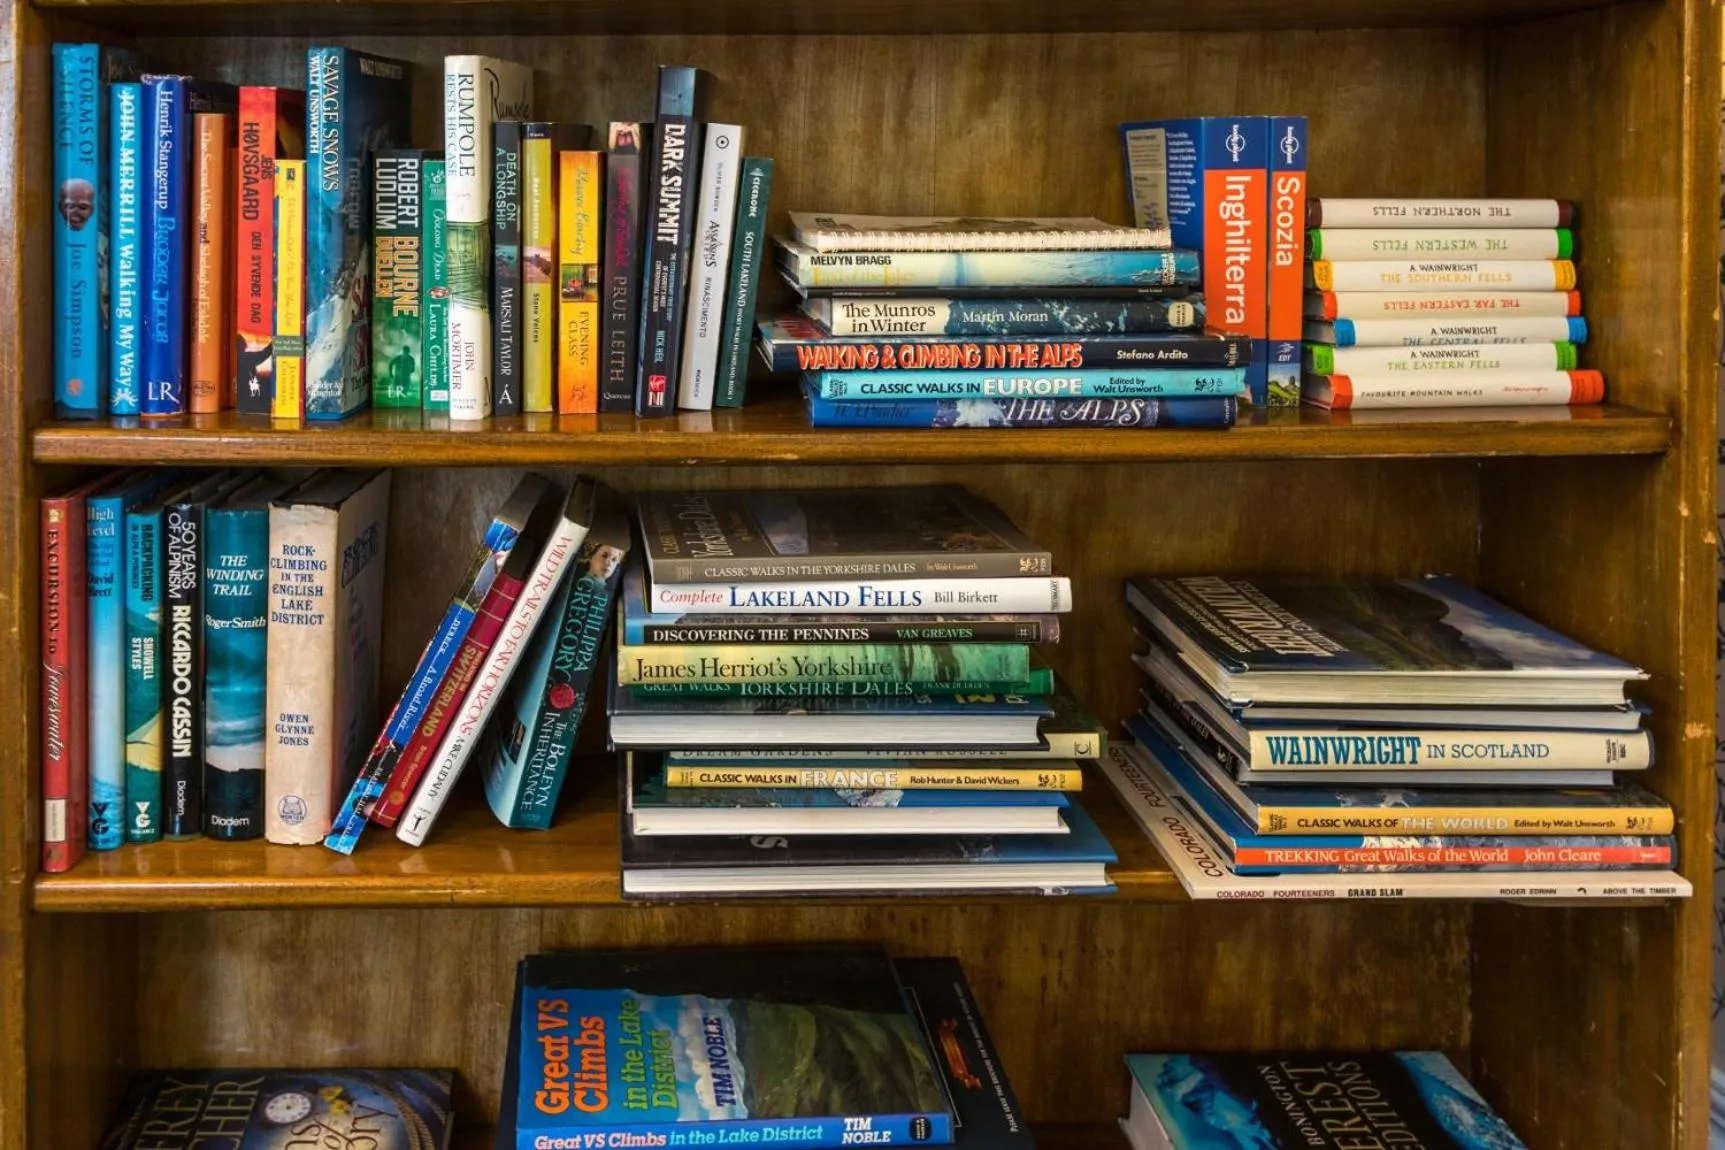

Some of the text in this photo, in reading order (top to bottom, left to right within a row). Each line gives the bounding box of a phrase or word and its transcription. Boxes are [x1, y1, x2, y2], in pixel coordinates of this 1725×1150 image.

[59, 70, 74, 151] SILENCE
[79, 56, 94, 166] STORMS OF
[309, 55, 320, 154] WALT UNSWORTH
[322, 56, 339, 191] SAVAGE SNOWS
[446, 74, 457, 176] RESTS HIS CASE
[458, 74, 475, 176] RUMPOLE
[156, 90, 174, 209] Henrik Stangerup
[261, 155, 275, 179] JENS
[661, 124, 687, 172] DARK
[243, 122, 260, 220] HØVSGAARD
[397, 158, 419, 227] ROBERT
[506, 152, 516, 221] DEATH ON
[375, 158, 397, 229] LUDLUM
[656, 175, 684, 245] SUMMIT
[748, 177, 760, 217] CICERONE
[1373, 206, 1512, 217] THE NORTHERN FELLS
[115, 93, 136, 386] JOHN MERRILL Walking My Way
[1276, 176, 1301, 266] Scozia
[375, 237, 393, 297] DUELLEN
[810, 255, 892, 267] MELVYN BRAGG
[1219, 175, 1252, 324] Inghilterra
[1372, 239, 1509, 251] THE WESTERN FELLS
[392, 237, 419, 317] BOURNE
[737, 231, 755, 307] SOUTH LAKELAND
[65, 243, 87, 359] Joe Simpson
[611, 276, 628, 321] PRUE
[699, 277, 713, 338] RINASCIMENTO
[843, 304, 936, 318] The Munros
[962, 311, 1048, 323] Martin Moran
[500, 287, 513, 375] MARSALI TAYLOR
[568, 321, 578, 357] CLASS
[579, 311, 590, 365] EVENING
[852, 319, 927, 333] in Winter
[451, 323, 462, 390] MORTIMER
[464, 342, 475, 371] JOHN
[610, 330, 625, 381] LEITH
[796, 342, 1084, 370] WALKING & CLIMBING IN THE ALPS
[1117, 349, 1189, 360] Stefano Ardito
[860, 383, 912, 394] CLASSIC
[916, 383, 963, 394] WALKS
[966, 383, 981, 394] IN
[983, 377, 1082, 396] EUROPE
[141, 524, 155, 602] BACKPACKING
[168, 513, 182, 598] OF ALPINISM
[181, 521, 196, 590] 50 YEARS
[220, 556, 248, 567] THE
[270, 559, 328, 571] CLIMBING
[282, 545, 317, 556] ROCK-
[206, 568, 265, 582] WINDING
[212, 584, 253, 597] TRAIL
[271, 585, 325, 597] ENGLISH
[281, 573, 314, 583] IN THE
[660, 585, 999, 608] Complete LAKELAND FELLS Bill Birkett
[271, 612, 326, 626] DISTRICT
[281, 599, 313, 612] LAKE
[1177, 576, 1336, 658] WAINWRIGHT
[554, 576, 594, 682] GREGORY
[574, 594, 609, 671] PHILIPPA
[653, 628, 974, 642] DISCOVERING THE PENNINES VAN GREAVES
[131, 637, 142, 670] STYLES
[143, 637, 154, 681] SHOWELL
[632, 655, 895, 683] James Herriot's Yorkshire
[171, 605, 193, 758] RICCARDO CASSIN
[421, 645, 477, 737] SWITZERLAND
[275, 724, 316, 736] GLYNNE
[279, 713, 310, 724] OWEN
[278, 736, 309, 747] JONES
[1266, 736, 1550, 766] WAINWRIGHT IN SCOTLAND
[175, 780, 186, 816] Diadem
[211, 815, 250, 828] Diadem
[1297, 818, 1342, 829] CLASSIC
[1344, 818, 1384, 829] WALKS
[1384, 818, 1400, 828] OF
[1401, 817, 1434, 830] THE
[1442, 817, 1510, 831] WORLD
[1264, 848, 1602, 864] TREKKING Great Walks of the World John Cleare
[1216, 889, 1336, 899] COLORADO FOURTEENERS
[1347, 888, 1404, 898] GRAND SLAM
[534, 998, 570, 1115] Great VS
[574, 1015, 610, 1114] Climbs
[617, 997, 650, 1111] in the Lake
[647, 1028, 678, 1110] District
[703, 1017, 738, 1109] TIM NOBLE
[534, 1125, 825, 1150] Great VS Climbs in the Lake District
[841, 1129, 893, 1146] NOBLE
[843, 1117, 874, 1133] TIM
